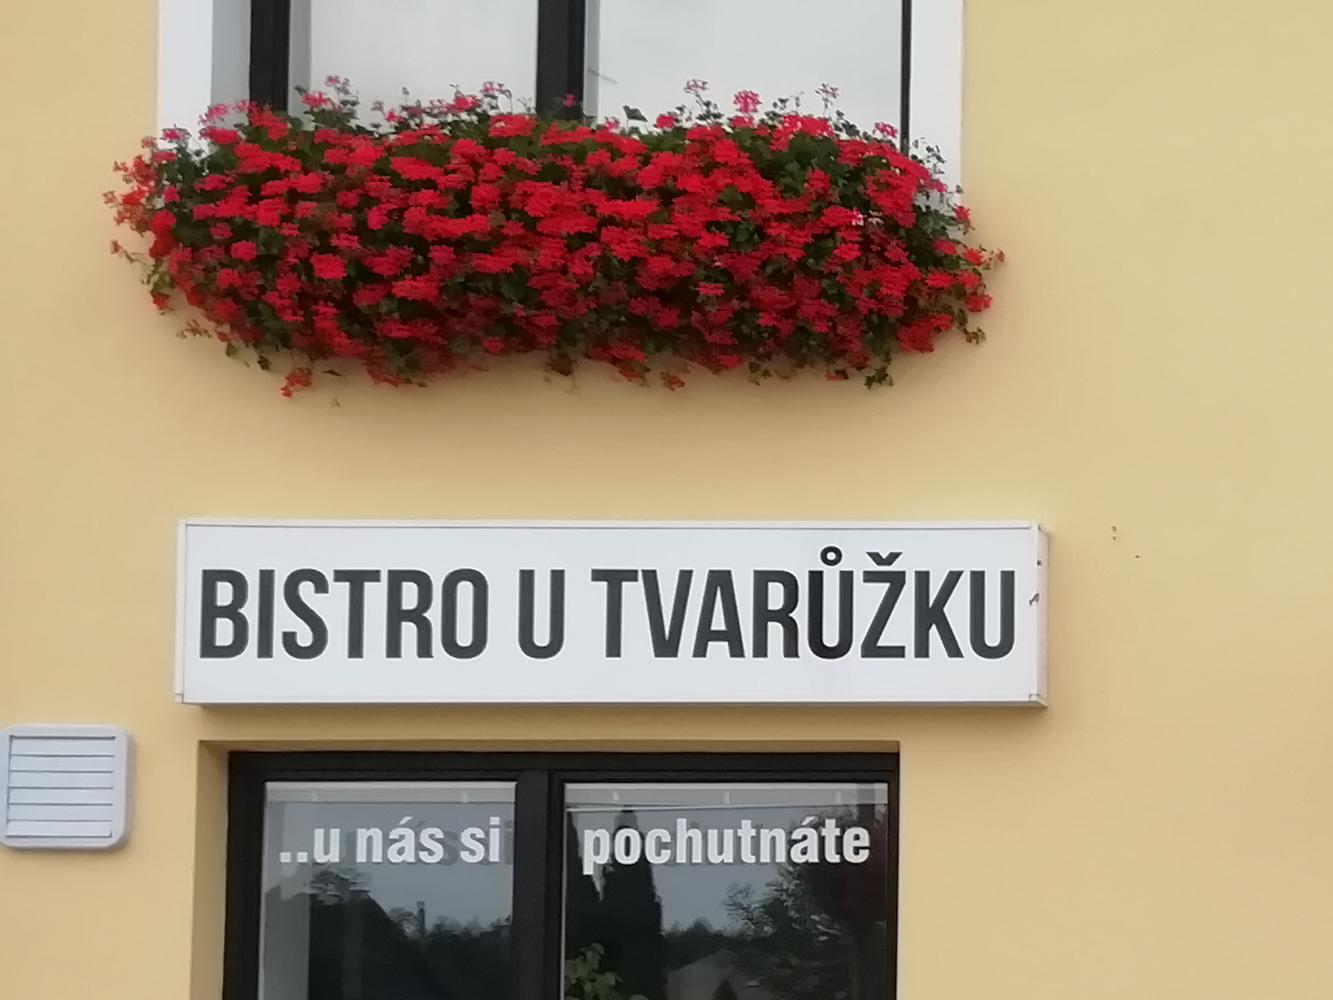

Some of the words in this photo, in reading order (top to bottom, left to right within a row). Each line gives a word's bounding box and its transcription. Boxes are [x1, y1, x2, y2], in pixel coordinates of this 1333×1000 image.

[199, 568, 489, 660] BISTRO
[518, 568, 565, 660] U
[591, 545, 1015, 660] TVARŮŽKU
[355, 815, 444, 863] nás
[459, 815, 500, 863] si
[582, 815, 869, 876] pochutnáte
